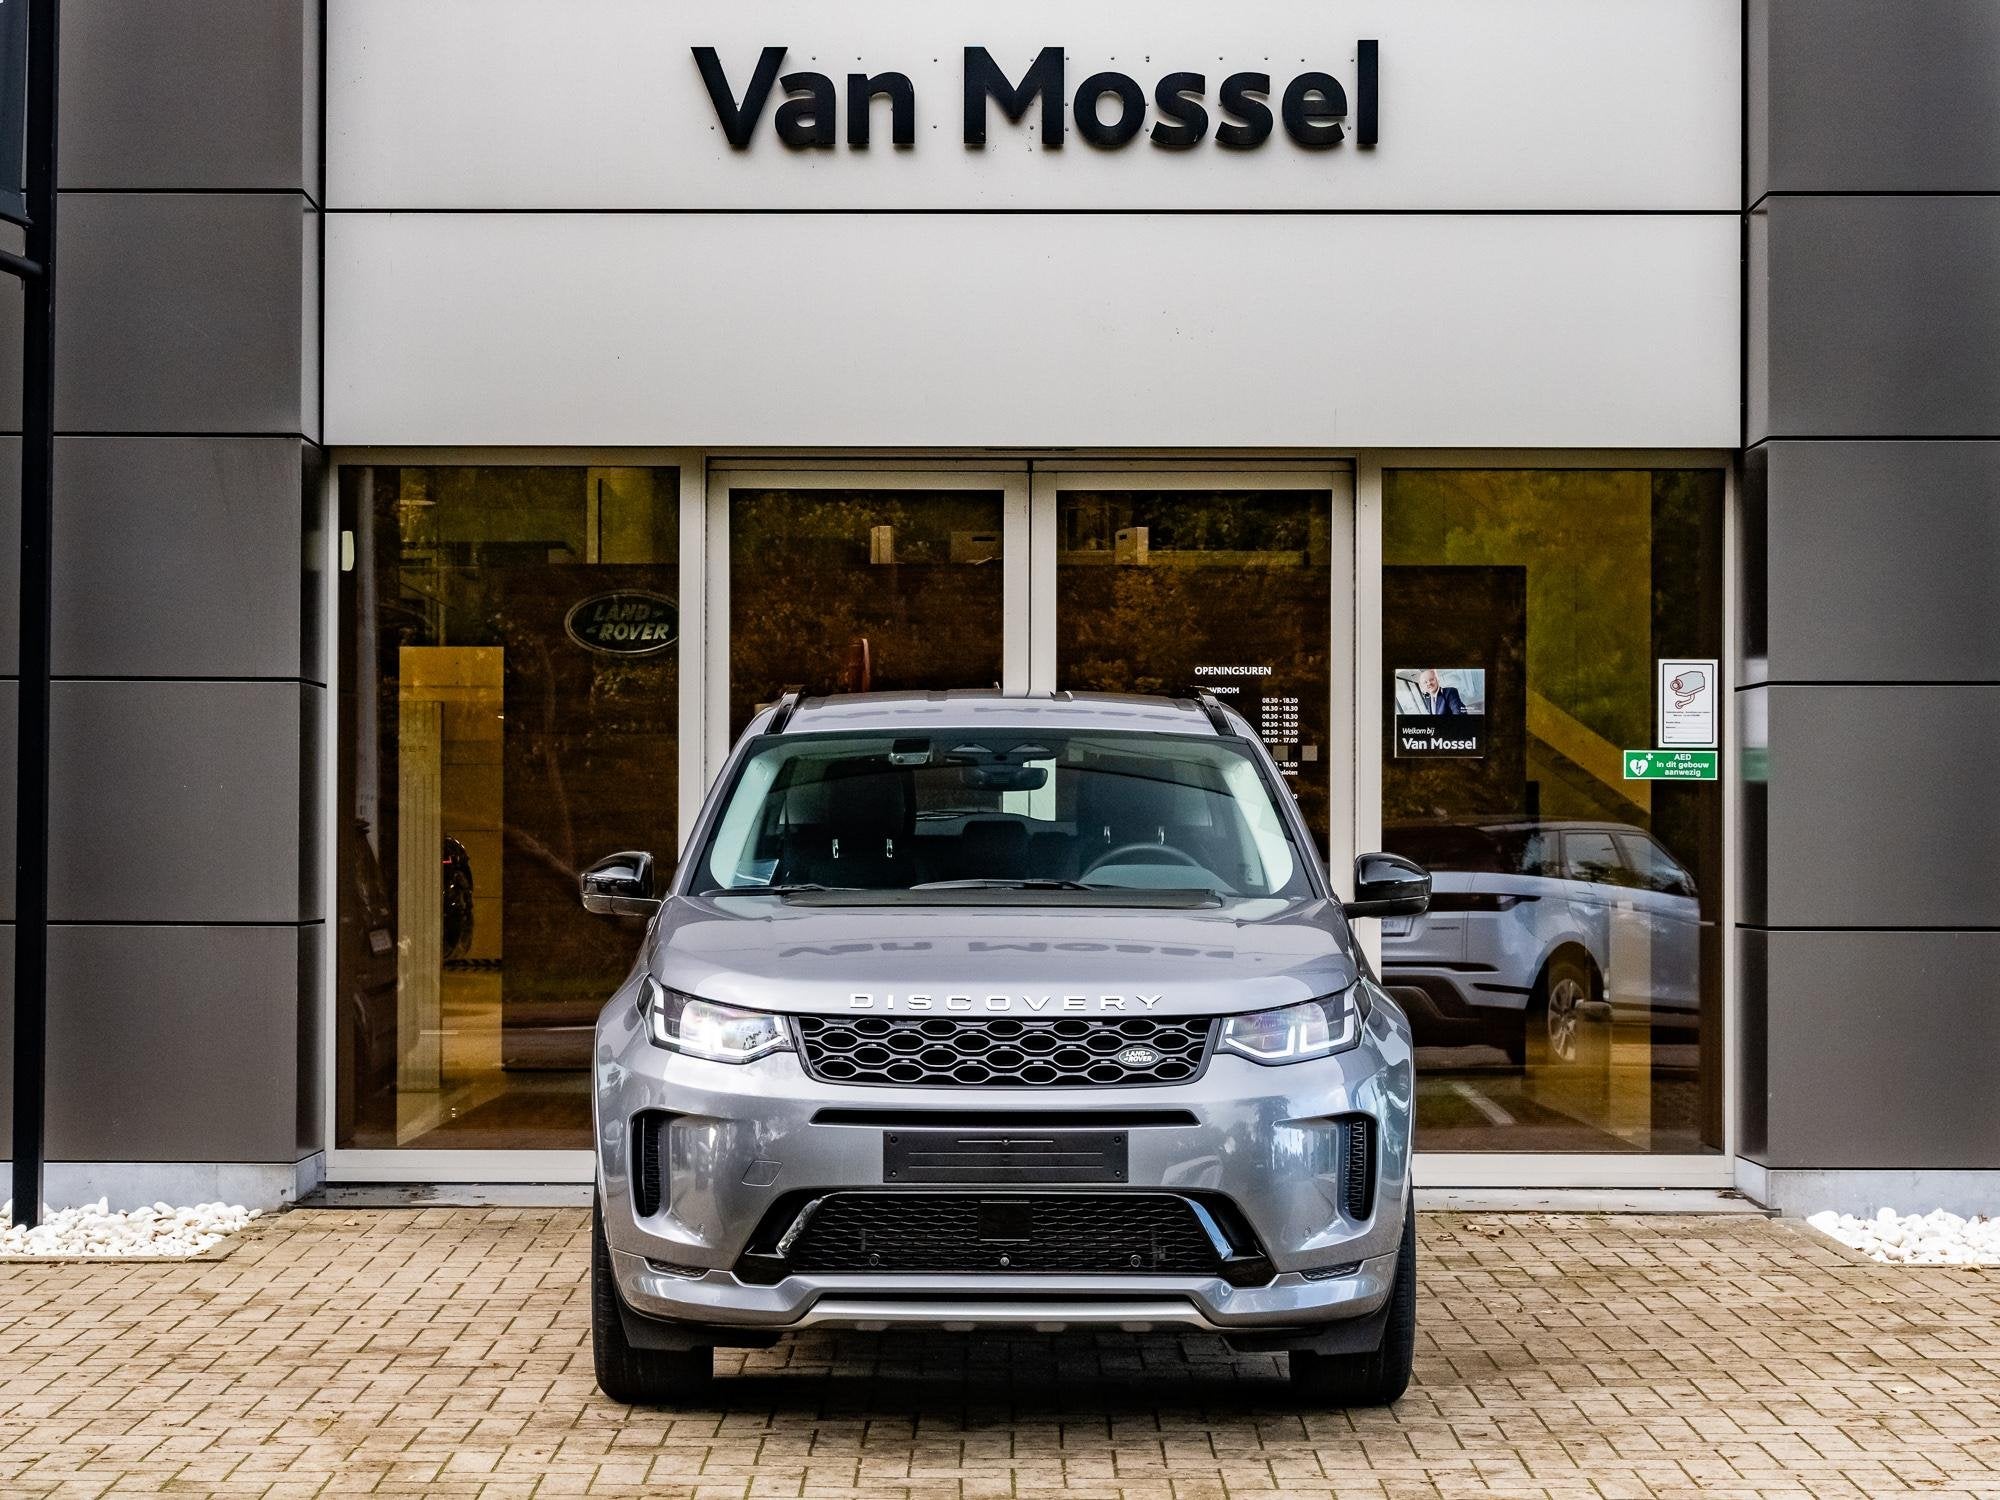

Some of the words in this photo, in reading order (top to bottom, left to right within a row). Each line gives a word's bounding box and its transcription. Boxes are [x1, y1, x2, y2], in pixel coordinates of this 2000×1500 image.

[691, 46, 915, 146] Van
[963, 39, 1379, 146] Mossel
[593, 603, 652, 621] LAND
[600, 623, 670, 641] ROVER
[1194, 666, 1272, 676] OPENINGSUREN
[1402, 727, 1426, 735] Welkom
[1426, 727, 1435, 737] bij
[1402, 737, 1428, 750] Van
[1430, 736, 1476, 750] Mossel
[1678, 761, 1709, 769] gebouw
[1664, 769, 1701, 777] aanwezig
[849, 993, 1163, 1011] DISCOVERY
[1128, 1055, 1152, 1063] ROVER
